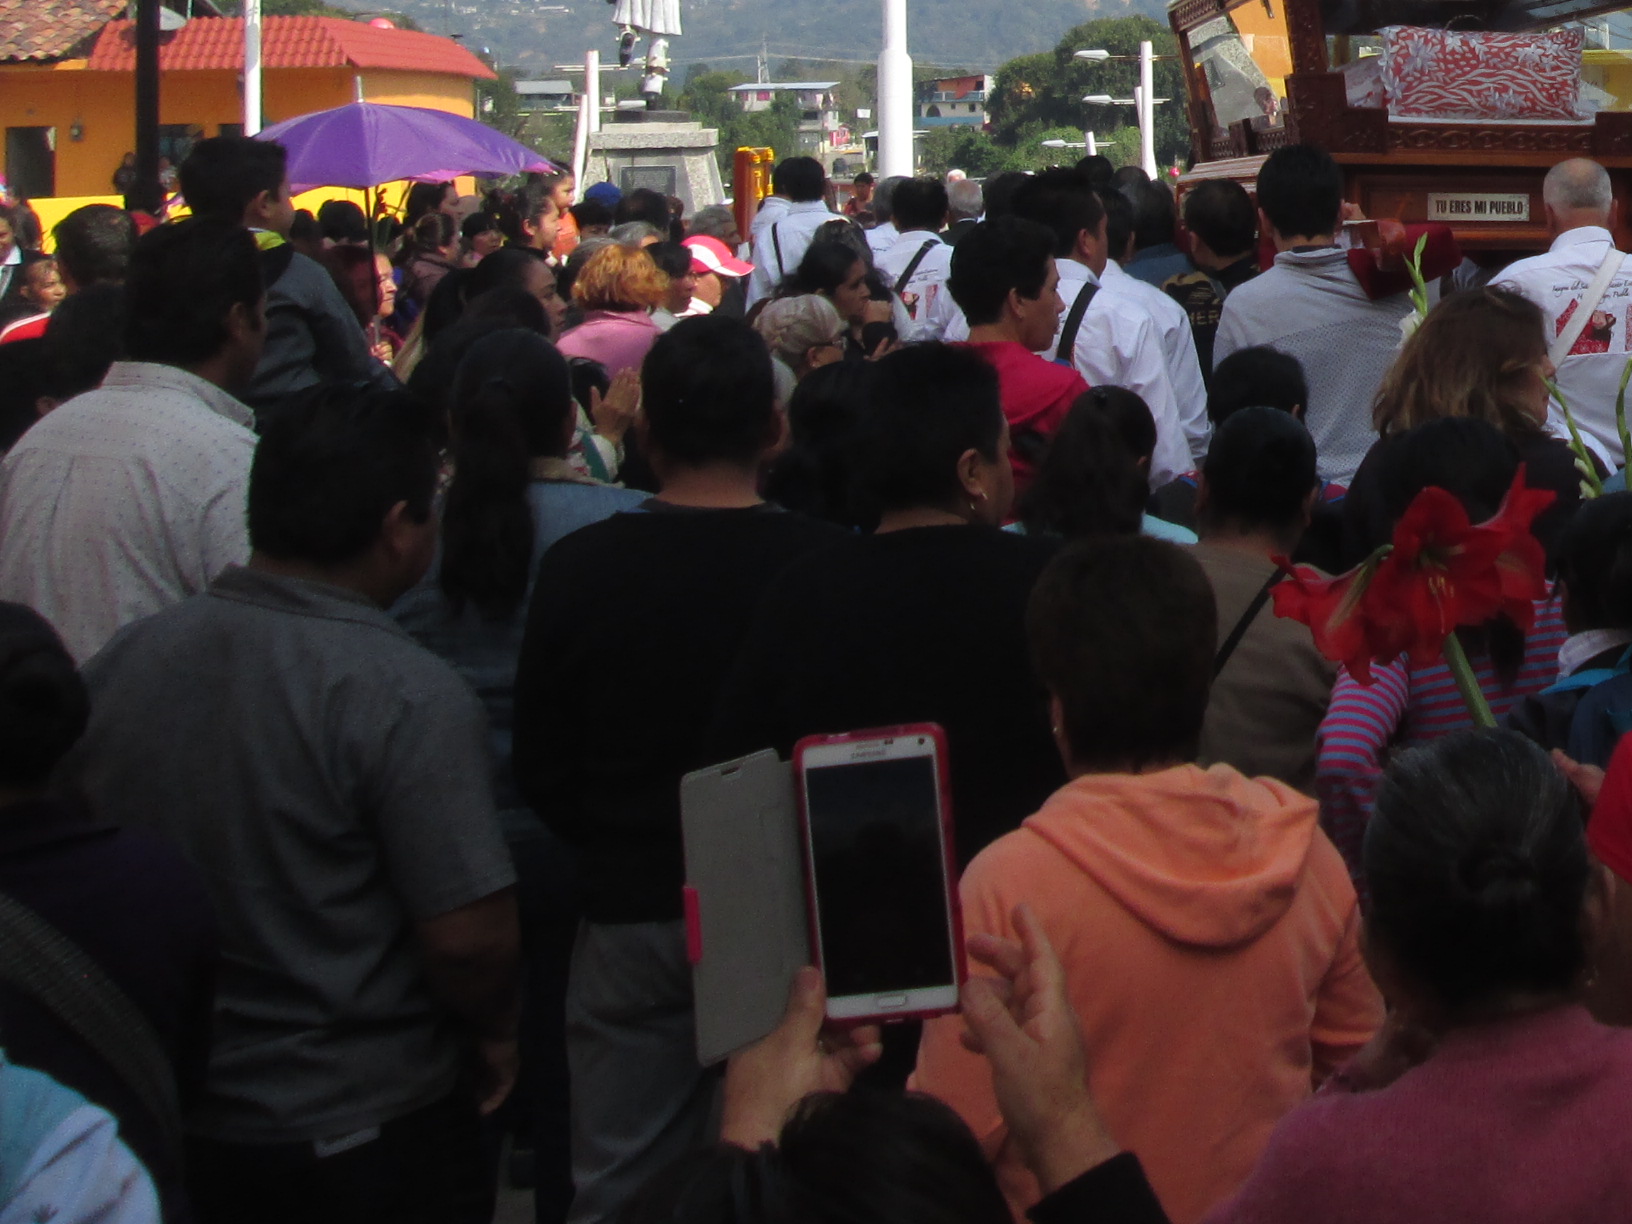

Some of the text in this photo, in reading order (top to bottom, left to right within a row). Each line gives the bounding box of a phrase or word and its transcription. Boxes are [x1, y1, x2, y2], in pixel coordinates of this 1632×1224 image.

[1436, 200, 1523, 214] TU ERES MI PUEBLO
